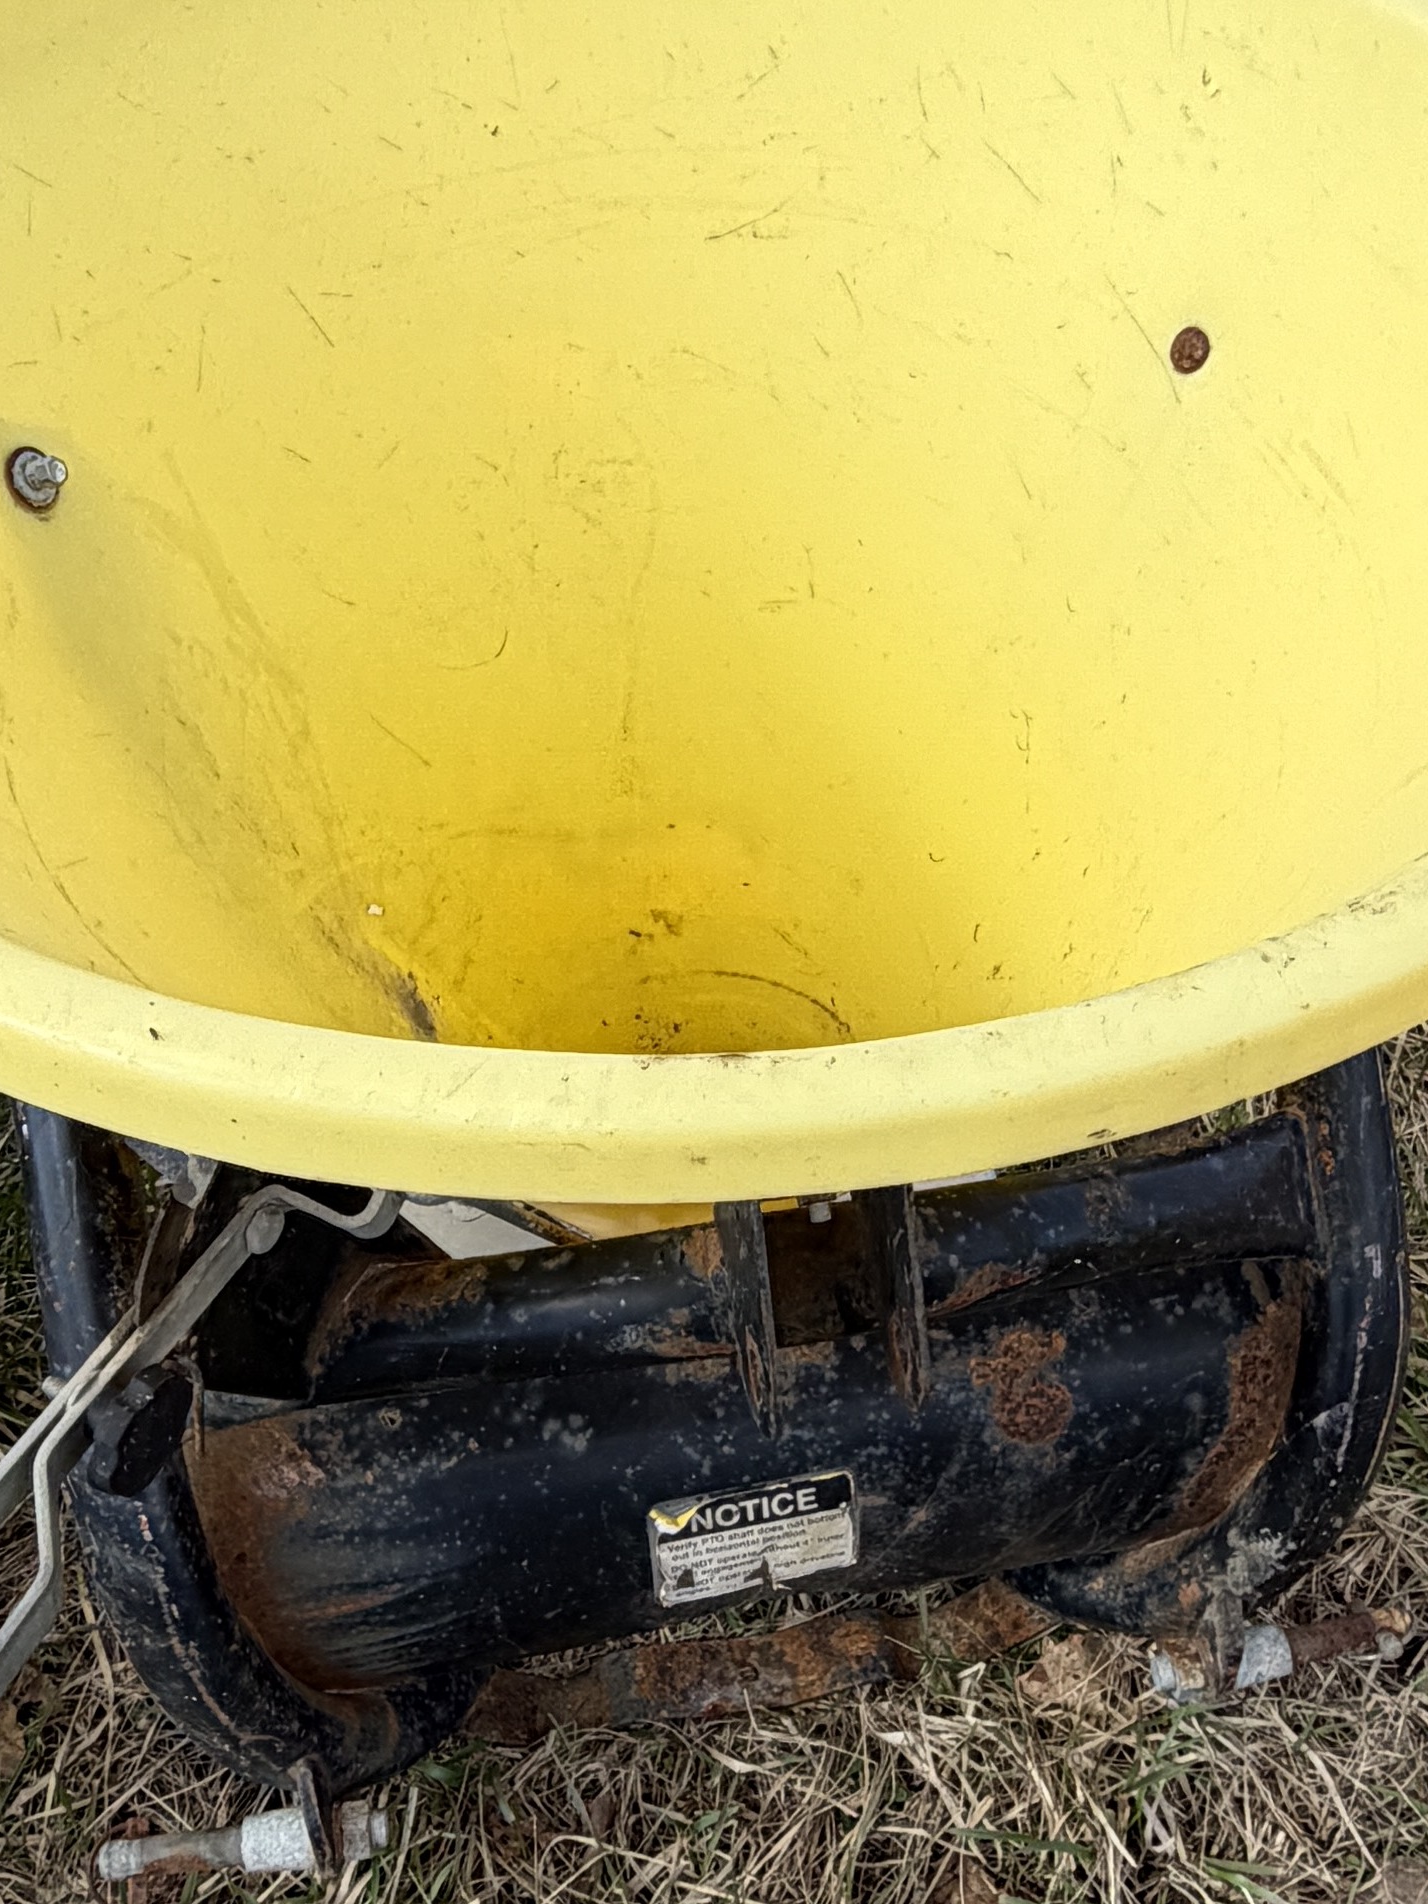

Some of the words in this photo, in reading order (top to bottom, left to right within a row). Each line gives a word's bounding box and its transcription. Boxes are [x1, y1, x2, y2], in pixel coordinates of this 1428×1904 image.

[691, 1487, 819, 1533] NOTICE
[667, 1540, 698, 1554] Verify
[701, 1534, 724, 1546] PTO
[728, 1528, 755, 1541] shaft
[757, 1524, 784, 1536] does
[786, 1518, 805, 1530] not
